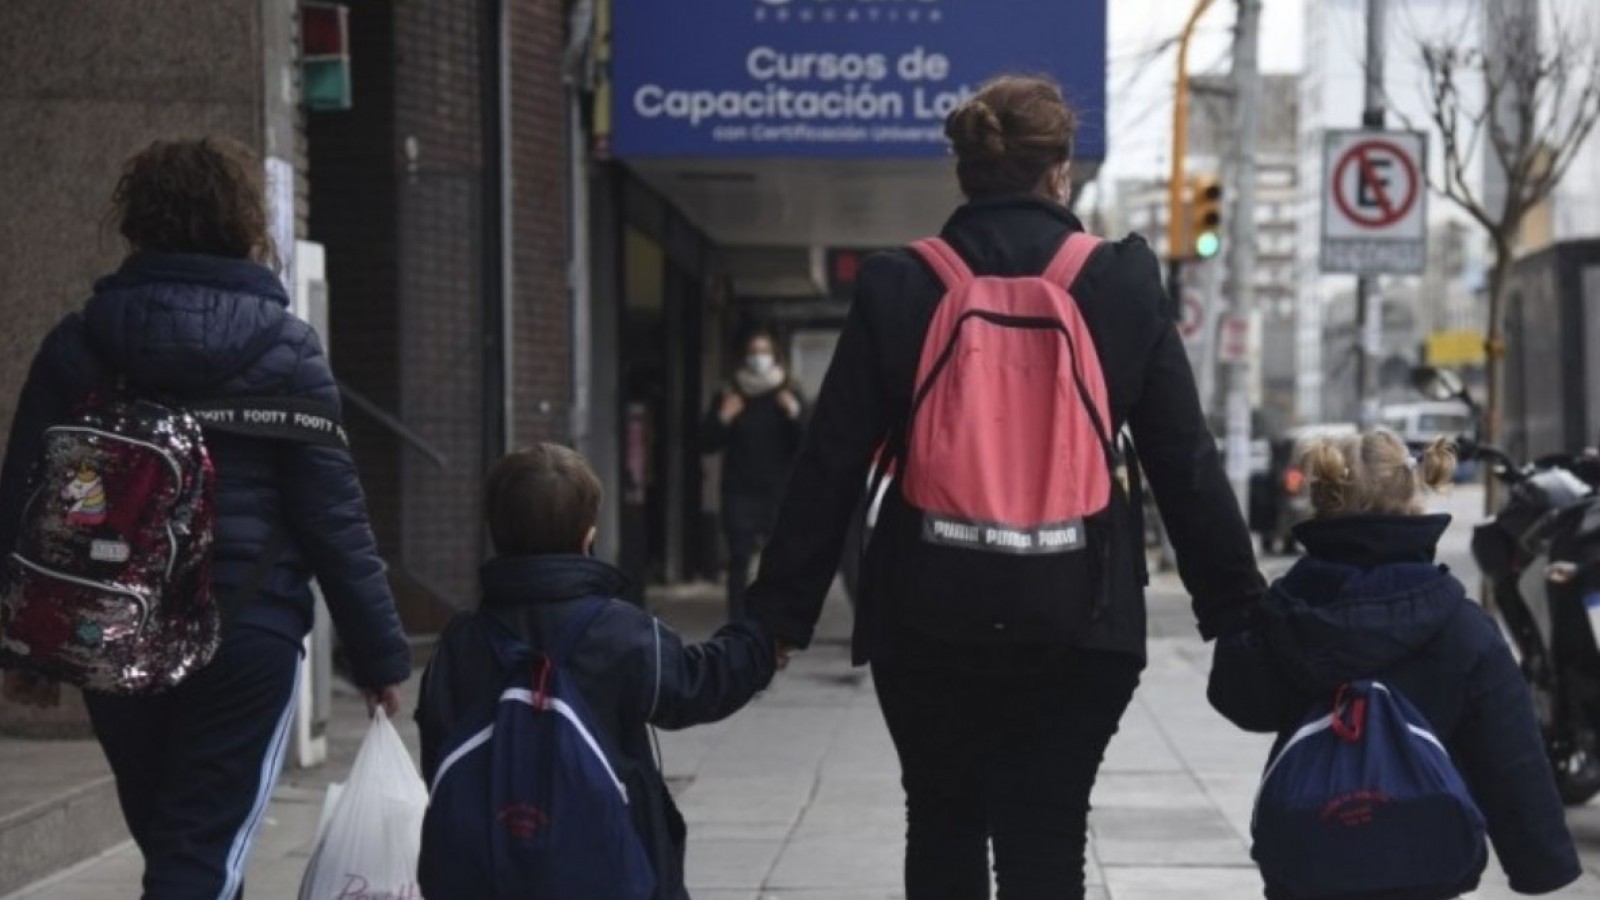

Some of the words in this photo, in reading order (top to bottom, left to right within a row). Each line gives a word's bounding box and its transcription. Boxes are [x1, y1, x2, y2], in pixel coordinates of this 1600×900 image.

[747, 47, 886, 80] Cursos
[898, 47, 950, 80] de
[634, 83, 903, 125] Capacitación
[713, 127, 748, 141] con
[1357, 160, 1392, 208] E
[243, 409, 287, 423] FOOTY
[294, 412, 334, 432] FOOTY
